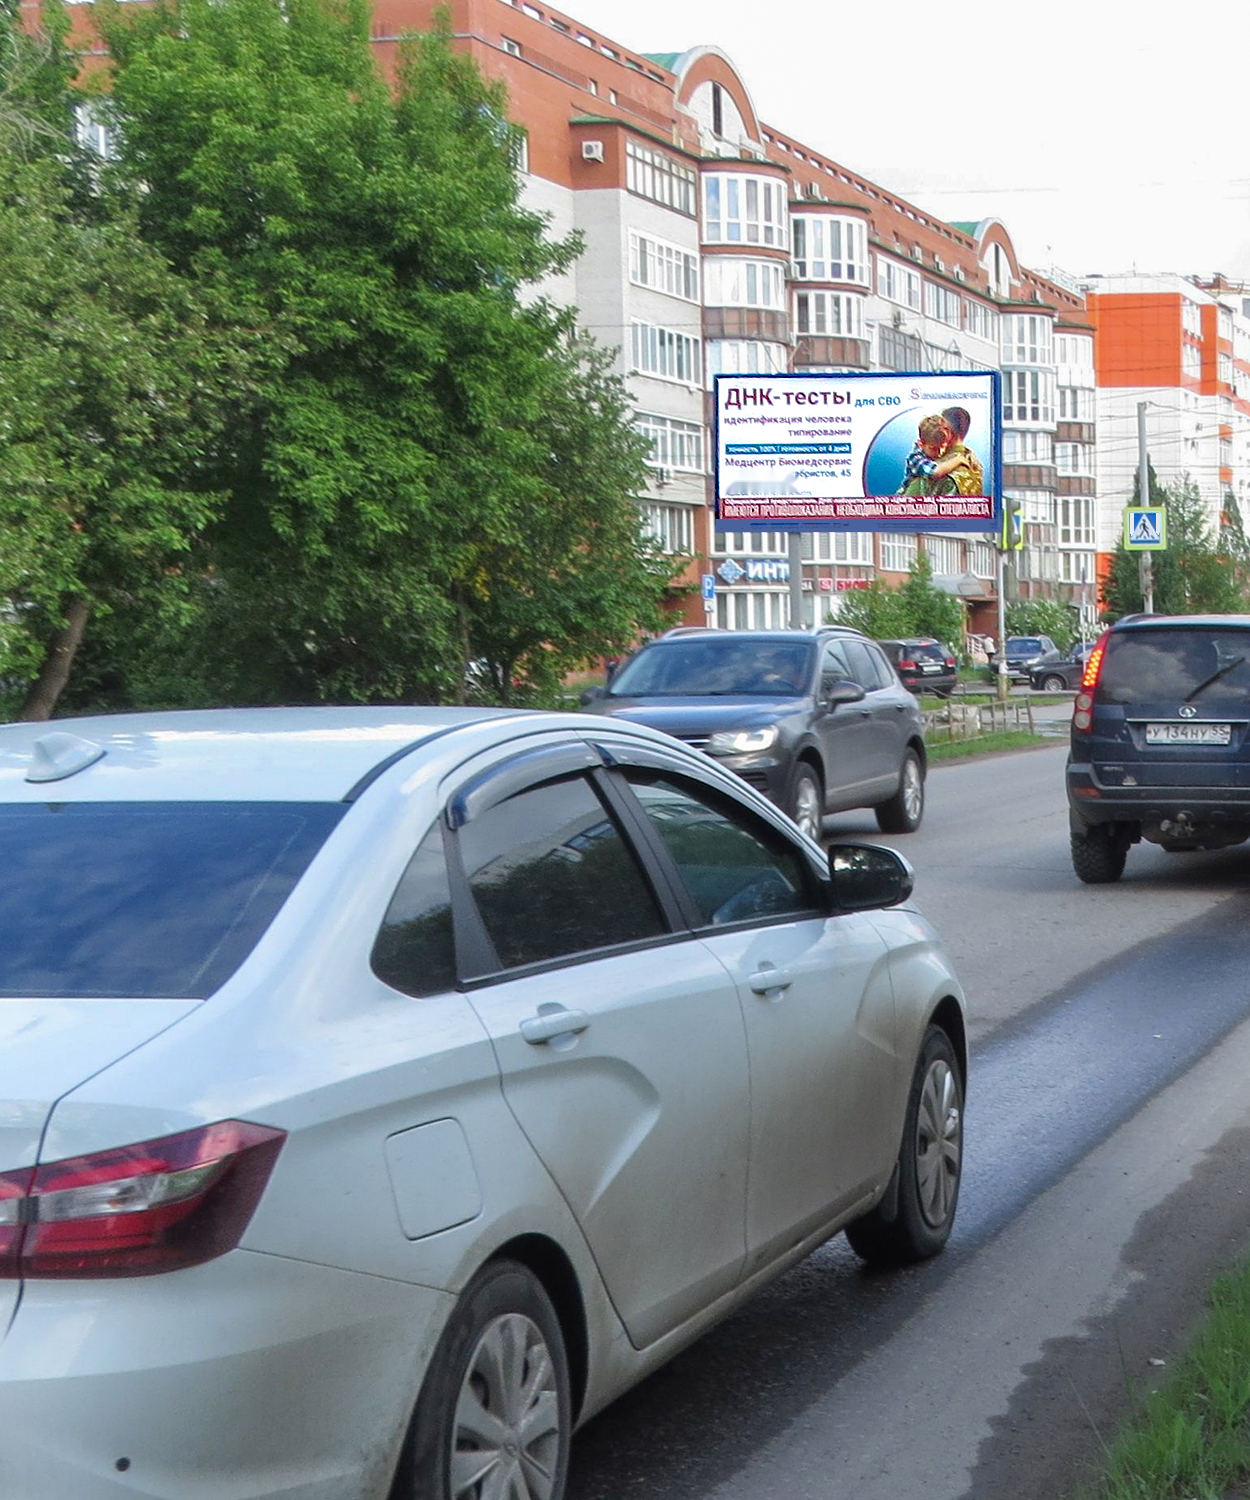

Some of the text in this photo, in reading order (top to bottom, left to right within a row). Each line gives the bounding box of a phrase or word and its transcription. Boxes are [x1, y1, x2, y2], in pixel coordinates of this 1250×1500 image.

[724, 387, 902, 410] ДНК-тесты для СВО
[724, 415, 853, 426] идентификация человека
[788, 429, 853, 438] типирование
[725, 456, 852, 468] Медцентр Биомедсервис
[840, 468, 852, 477] 45
[724, 504, 759, 516] ИМЕЮТСЯ
[836, 503, 884, 516] НЕОБХОДИМА
[939, 502, 990, 515] СПЕЦИАЛИСТА
